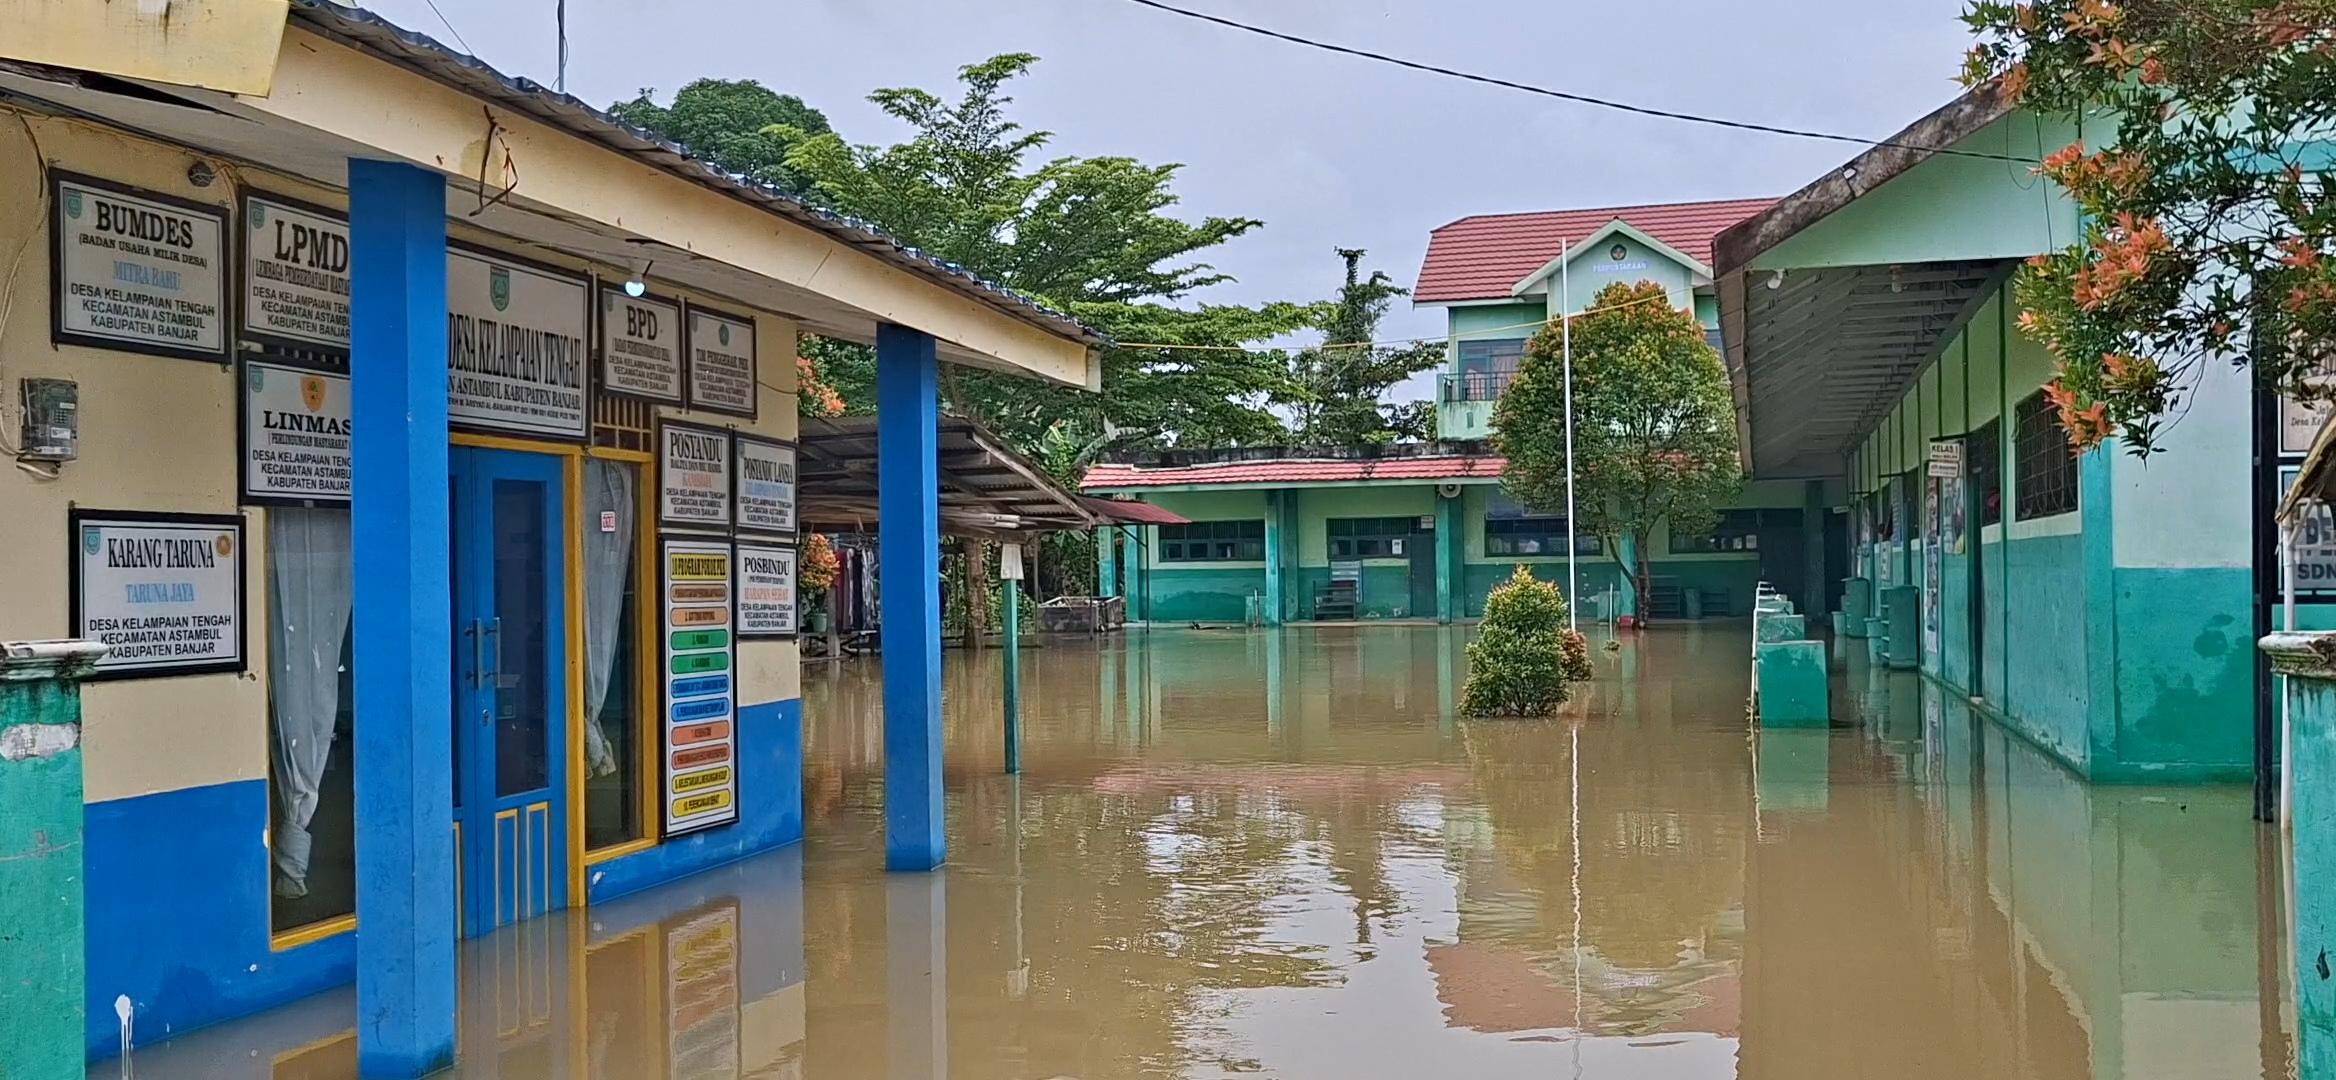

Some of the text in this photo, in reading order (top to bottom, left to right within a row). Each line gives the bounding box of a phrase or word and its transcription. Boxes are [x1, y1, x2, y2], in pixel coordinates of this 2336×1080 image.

[95, 201, 193, 249] BUMDES
[80, 233, 207, 269] (BADAN USAHA MILIK DESA)
[275, 219, 349, 273] LPMD
[113, 261, 181, 290] MITRA BARU
[71, 283, 215, 316] DESA KELAMPAIAN TENGAH
[253, 286, 276, 300] DESA
[279, 292, 331, 310] KELAMPAIAN
[261, 301, 313, 320] KECAMATAN
[82, 300, 205, 329] KECAMATAN ASTAMBUL
[268, 314, 350, 338] KABUPATEN BANJAR
[626, 305, 657, 340] BPD
[91, 315, 198, 341] KABUPATEN BANJAR
[448, 312, 476, 373] DESA
[479, 318, 542, 385] KELAMPAIAN
[544, 332, 581, 389] TENGAH
[457, 378, 502, 399] ASTAMBUL
[504, 384, 551, 406] KABUPATEN
[552, 391, 580, 410] BANJAR
[264, 411, 351, 436] LINMAS
[253, 449, 275, 461] DESA
[278, 452, 330, 466] KELAMPAIAN
[670, 432, 723, 463] POSYANDU
[1932, 445, 1953, 453] KELAS
[261, 463, 312, 476] KECAMATAN
[744, 457, 772, 482] POSYANDU
[267, 476, 350, 490] KABUPATEN BANJAR
[107, 538, 215, 568] KARANG TARUNA
[744, 557, 790, 576] POSBINDU
[2297, 563, 2336, 579] SDN
[125, 583, 194, 603] TARUNA JAYA
[89, 615, 231, 631] DESA KELAMPAIAN TENGAH
[101, 629, 222, 645] KECAMATAN ASTAMBUL
[109, 642, 215, 659] KABUPATEN BANJAR
